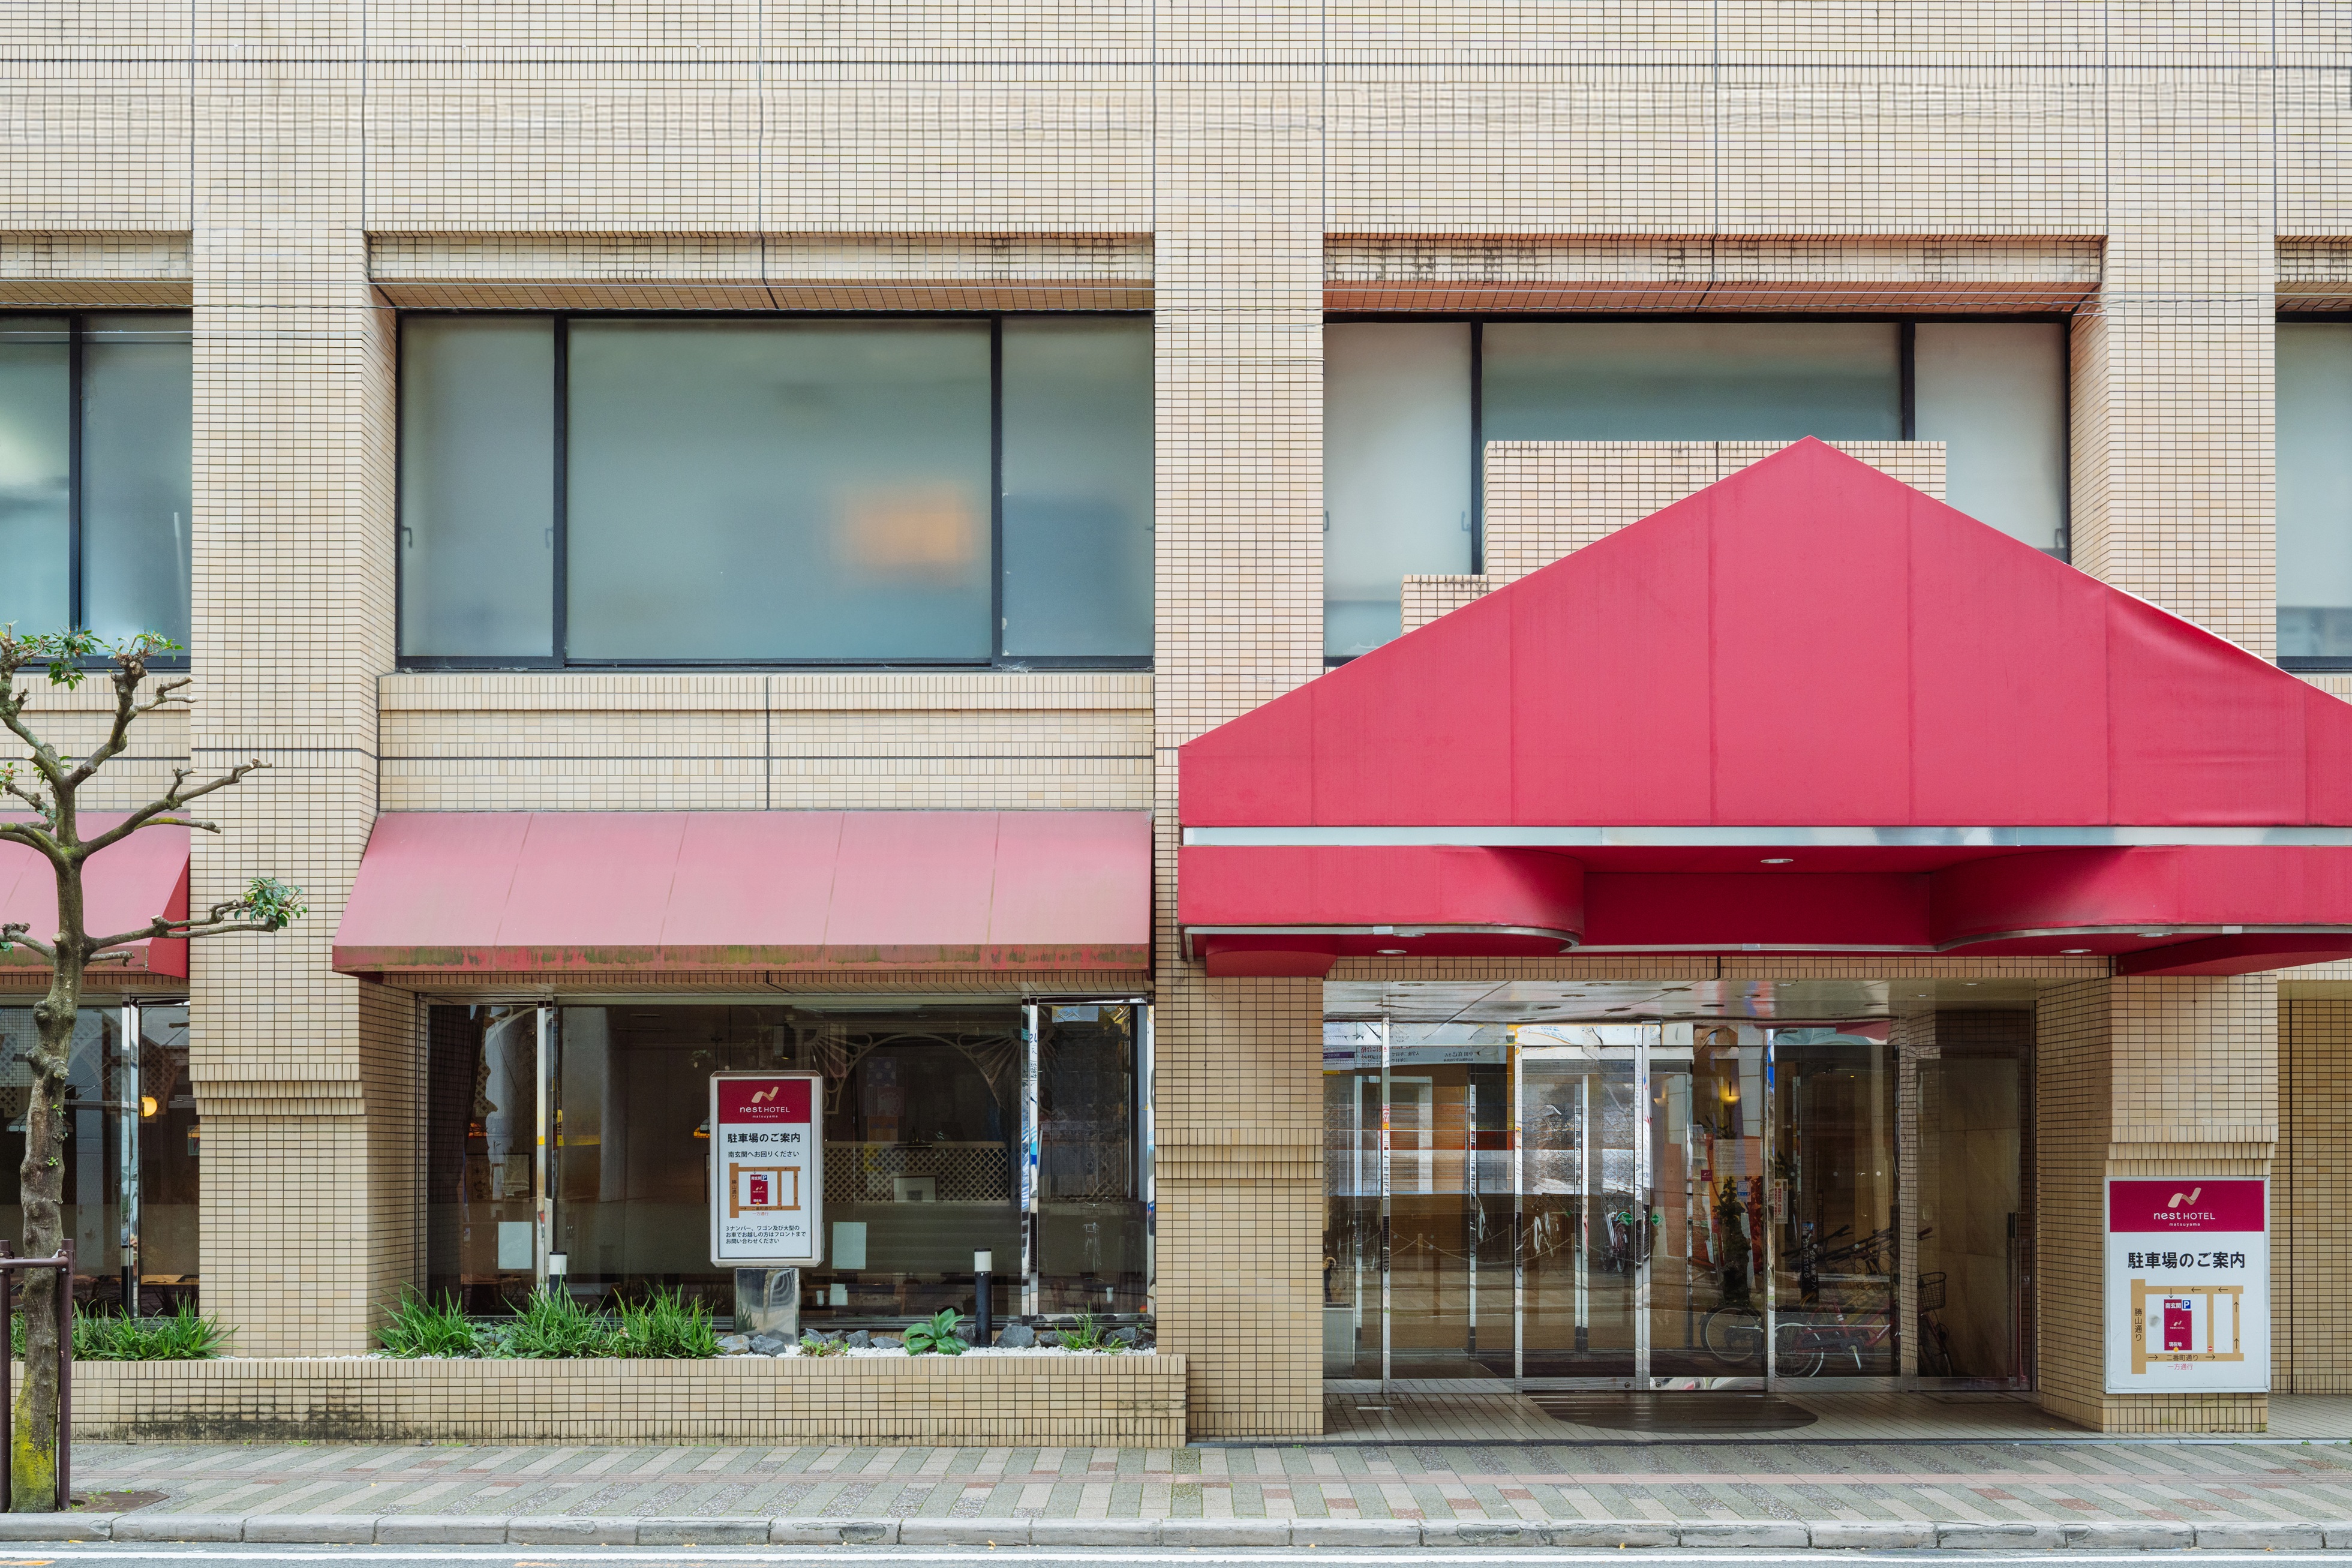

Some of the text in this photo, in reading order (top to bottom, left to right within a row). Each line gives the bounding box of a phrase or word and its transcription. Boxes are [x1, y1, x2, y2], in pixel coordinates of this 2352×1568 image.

[727, 1133, 800, 1143] 駐車場のご案内
[2153, 1212, 2182, 1220] nest
[2128, 1251, 2245, 1269] 駐車場のご案内
